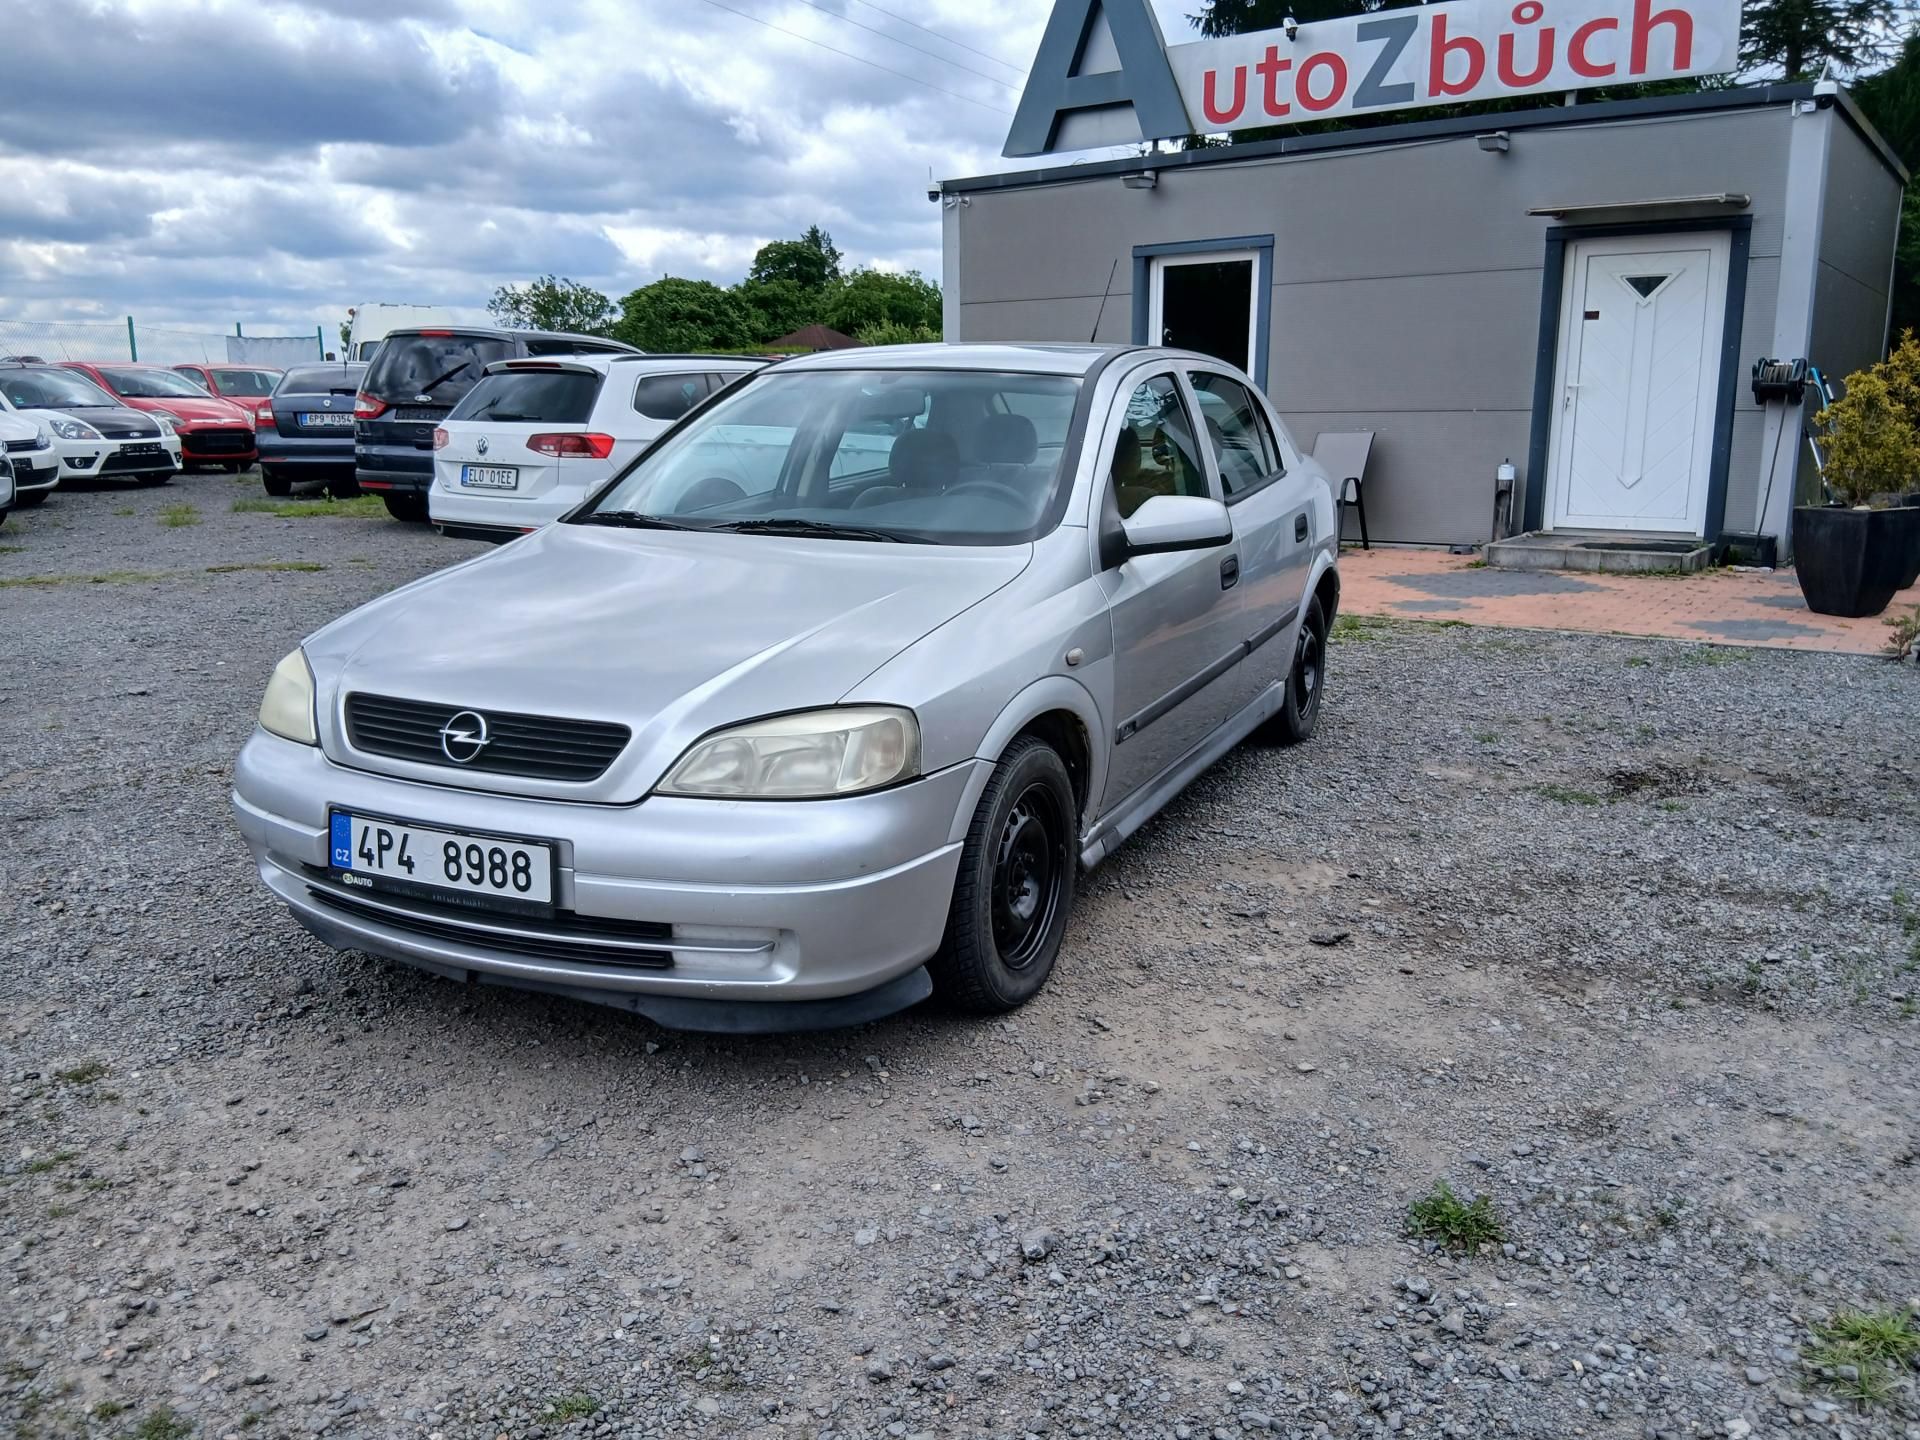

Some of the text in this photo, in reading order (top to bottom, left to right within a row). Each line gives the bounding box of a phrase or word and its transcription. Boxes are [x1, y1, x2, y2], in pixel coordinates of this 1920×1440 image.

[308, 412, 352, 424] 6P9 0354
[335, 848, 350, 862] CZ
[358, 825, 532, 892] 4P4 8988
